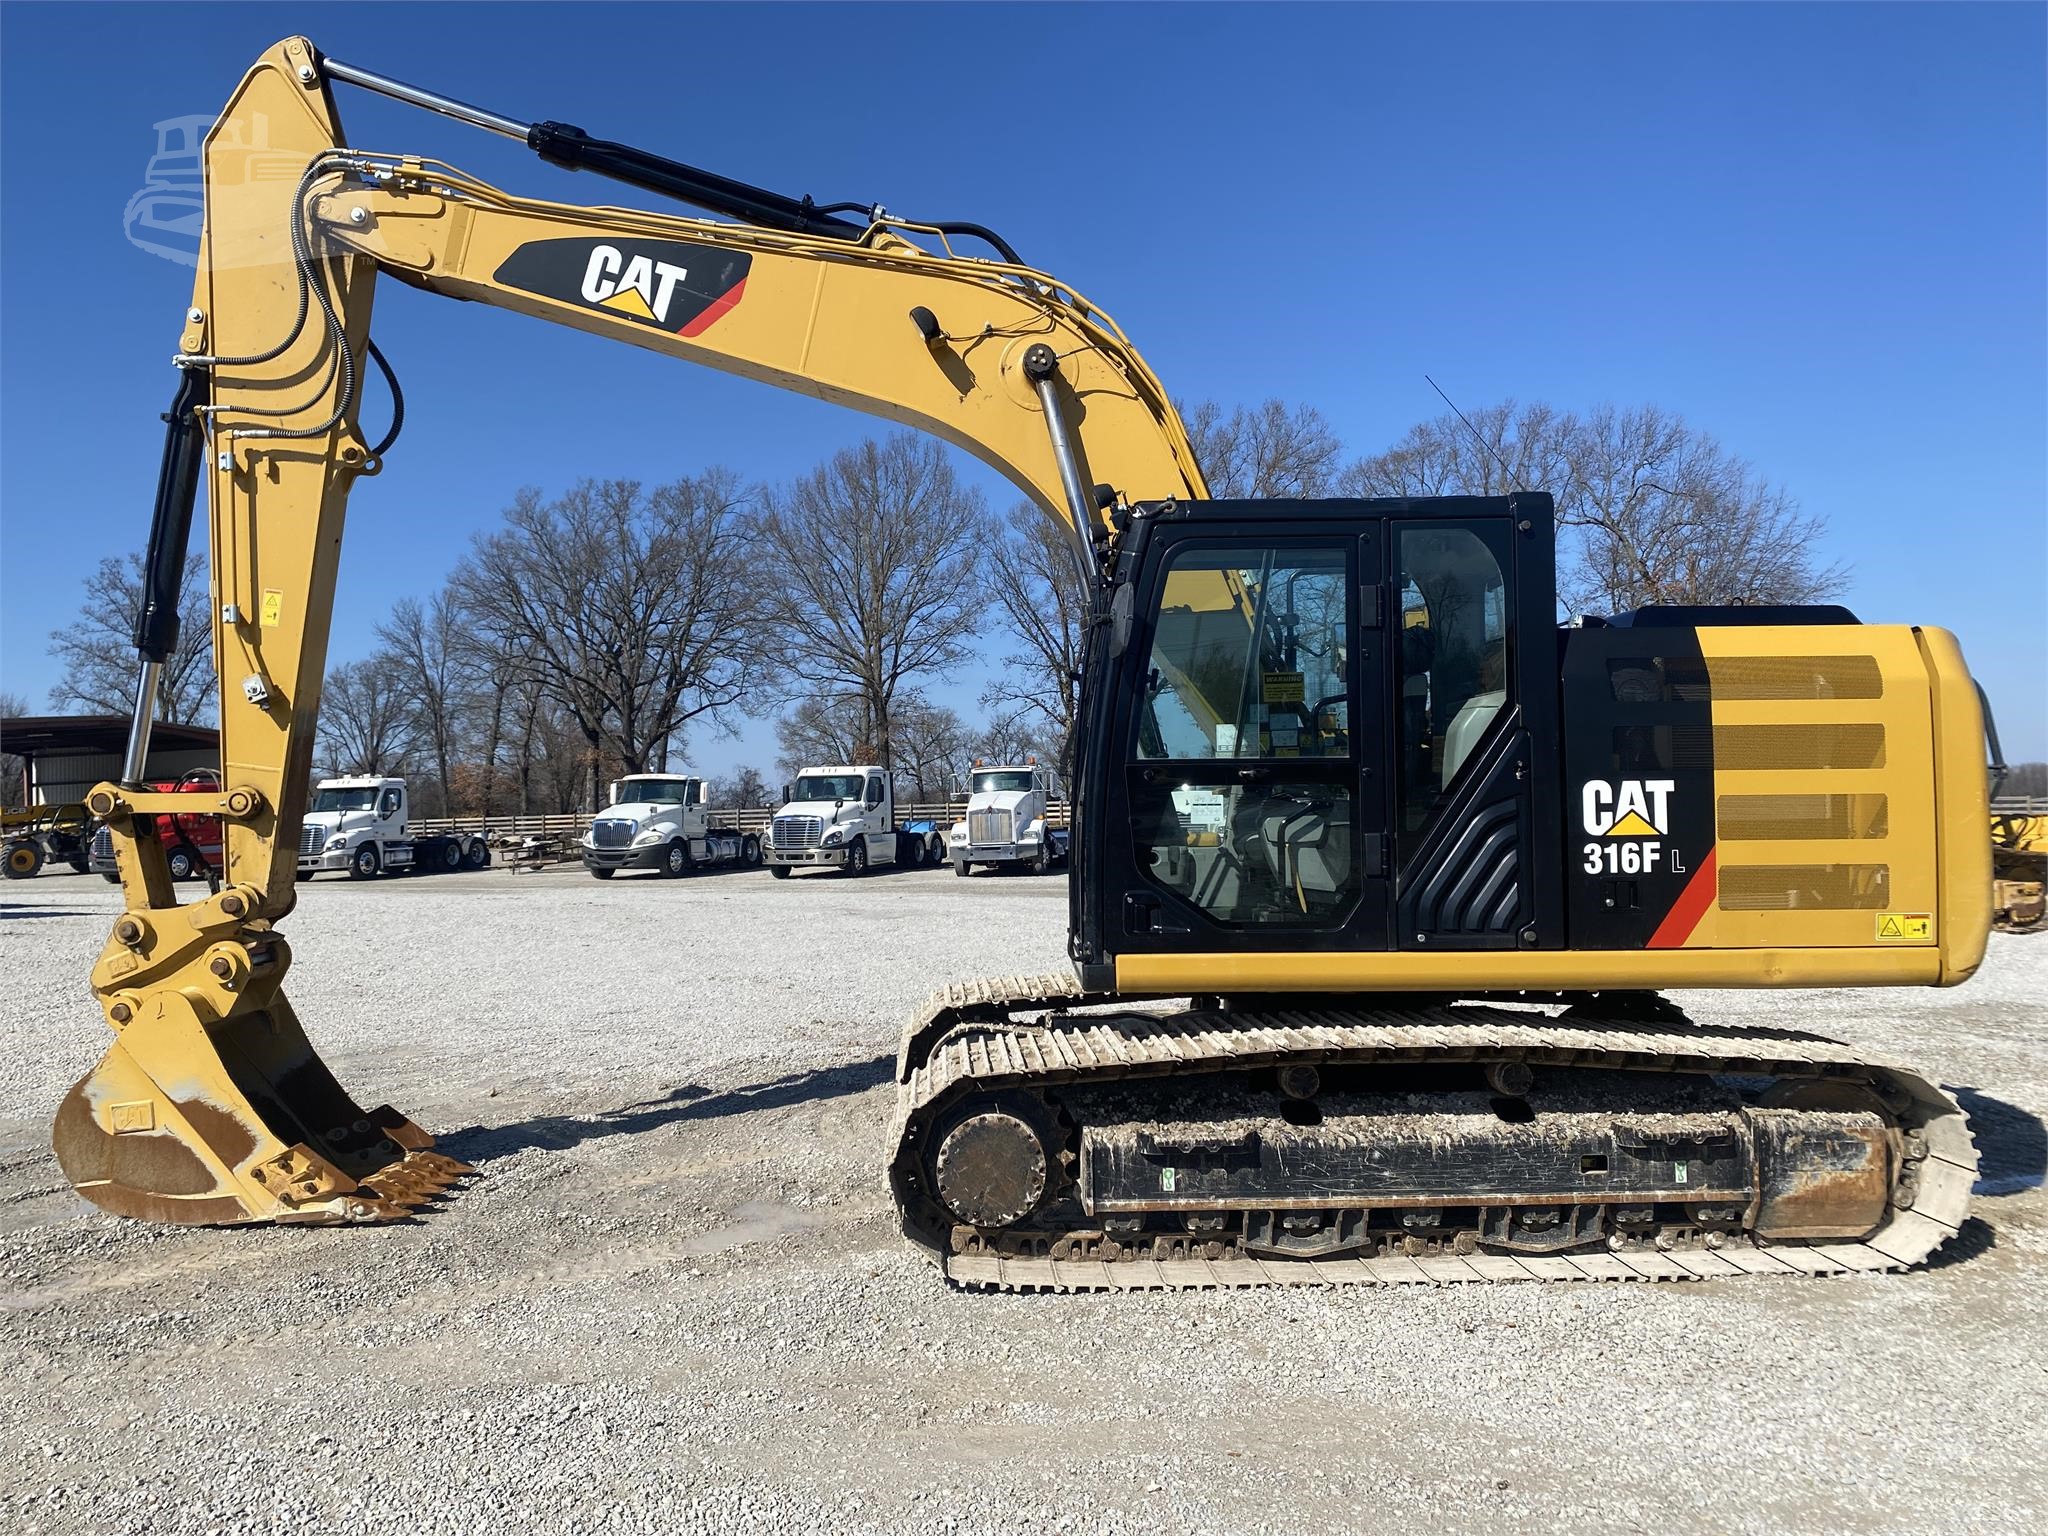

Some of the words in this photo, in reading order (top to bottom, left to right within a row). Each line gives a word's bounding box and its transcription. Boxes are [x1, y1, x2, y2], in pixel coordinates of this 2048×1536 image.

[581, 245, 688, 323] CAT
[4, 807, 26, 816] JCB
[1582, 779, 1675, 836] CAT
[1583, 841, 1661, 875] 316F
[1671, 849, 1686, 873] L
